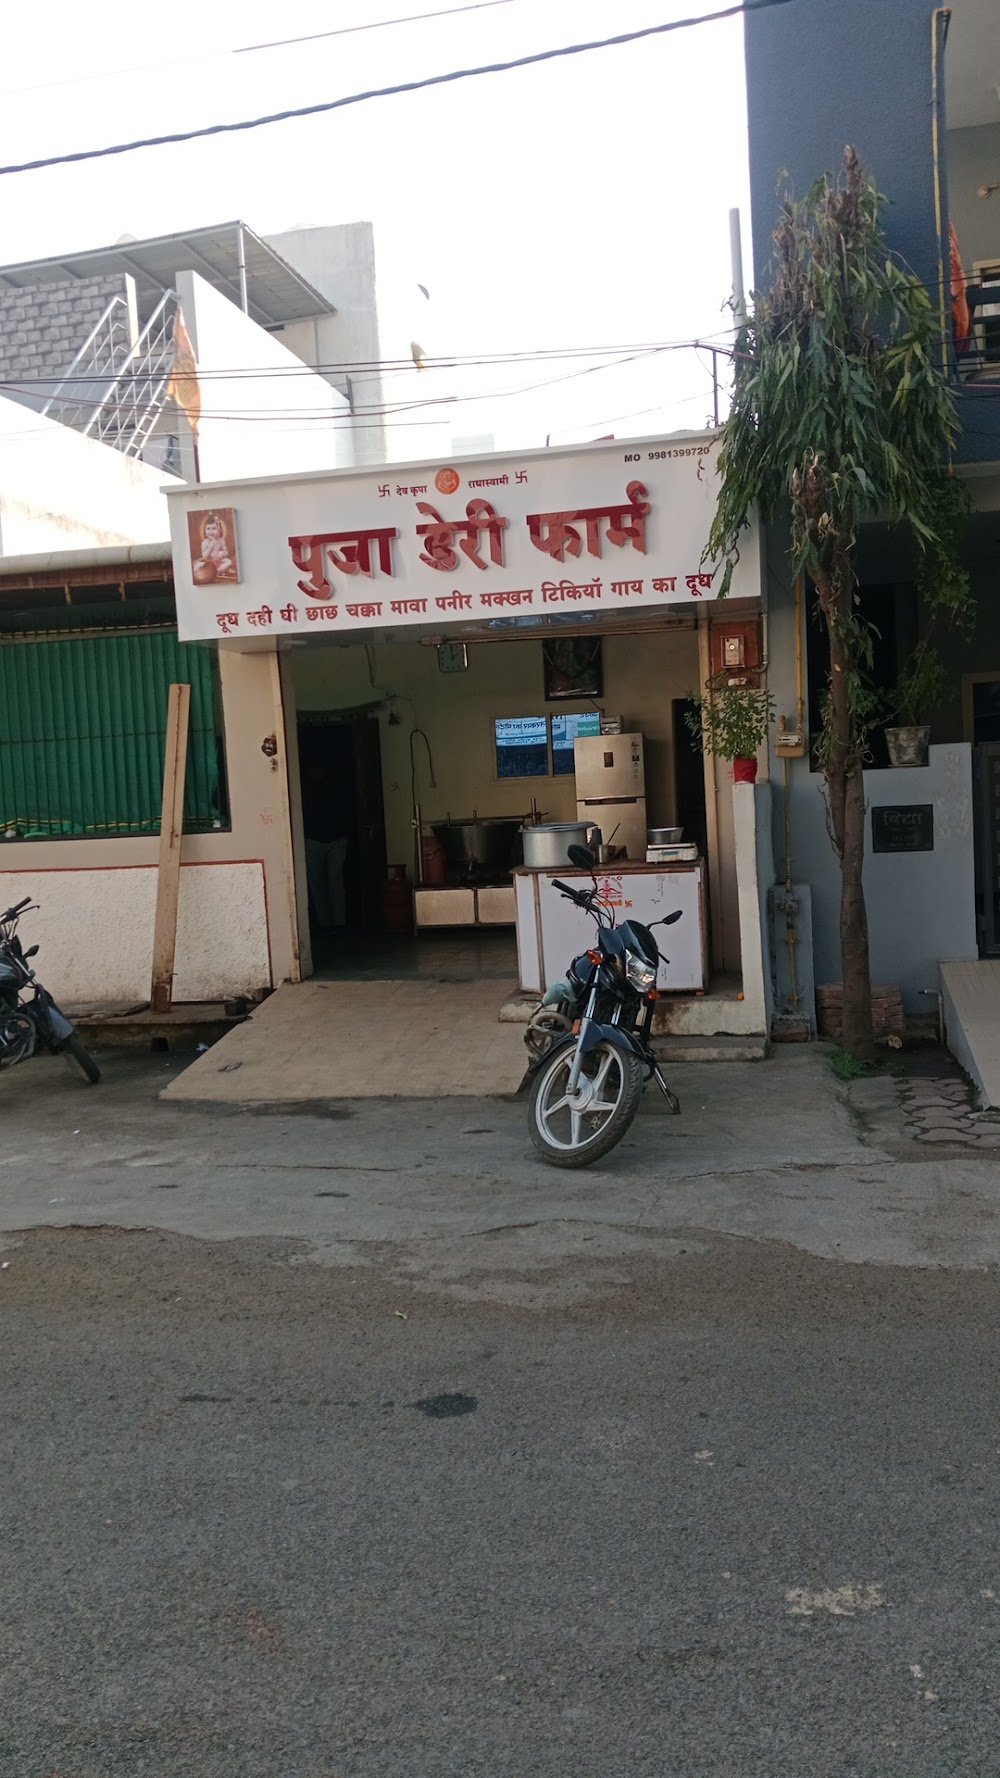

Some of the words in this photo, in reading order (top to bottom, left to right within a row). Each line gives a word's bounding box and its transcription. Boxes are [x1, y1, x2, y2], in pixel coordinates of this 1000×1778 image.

[624, 453, 641, 463] MO
[648, 446, 710, 460] 9981399720
[468, 474, 509, 489] राधास्वामी
[396, 484, 408, 497] देव
[410, 484, 428, 497] कृपा
[288, 527, 399, 601] पुजा
[416, 498, 509, 572] डेरी
[526, 480, 652, 563] फार्म
[216, 611, 240, 634] दूध
[246, 604, 273, 627] दही
[280, 602, 298, 624] घी
[305, 604, 339, 621] छाछ
[345, 601, 383, 618] चक्का
[390, 598, 428, 615] मावा
[435, 590, 472, 611] पनीर
[480, 589, 533, 608] मक्खन
[610, 579, 644, 596] गाय
[652, 576, 677, 593] का
[685, 573, 713, 597] दूध
